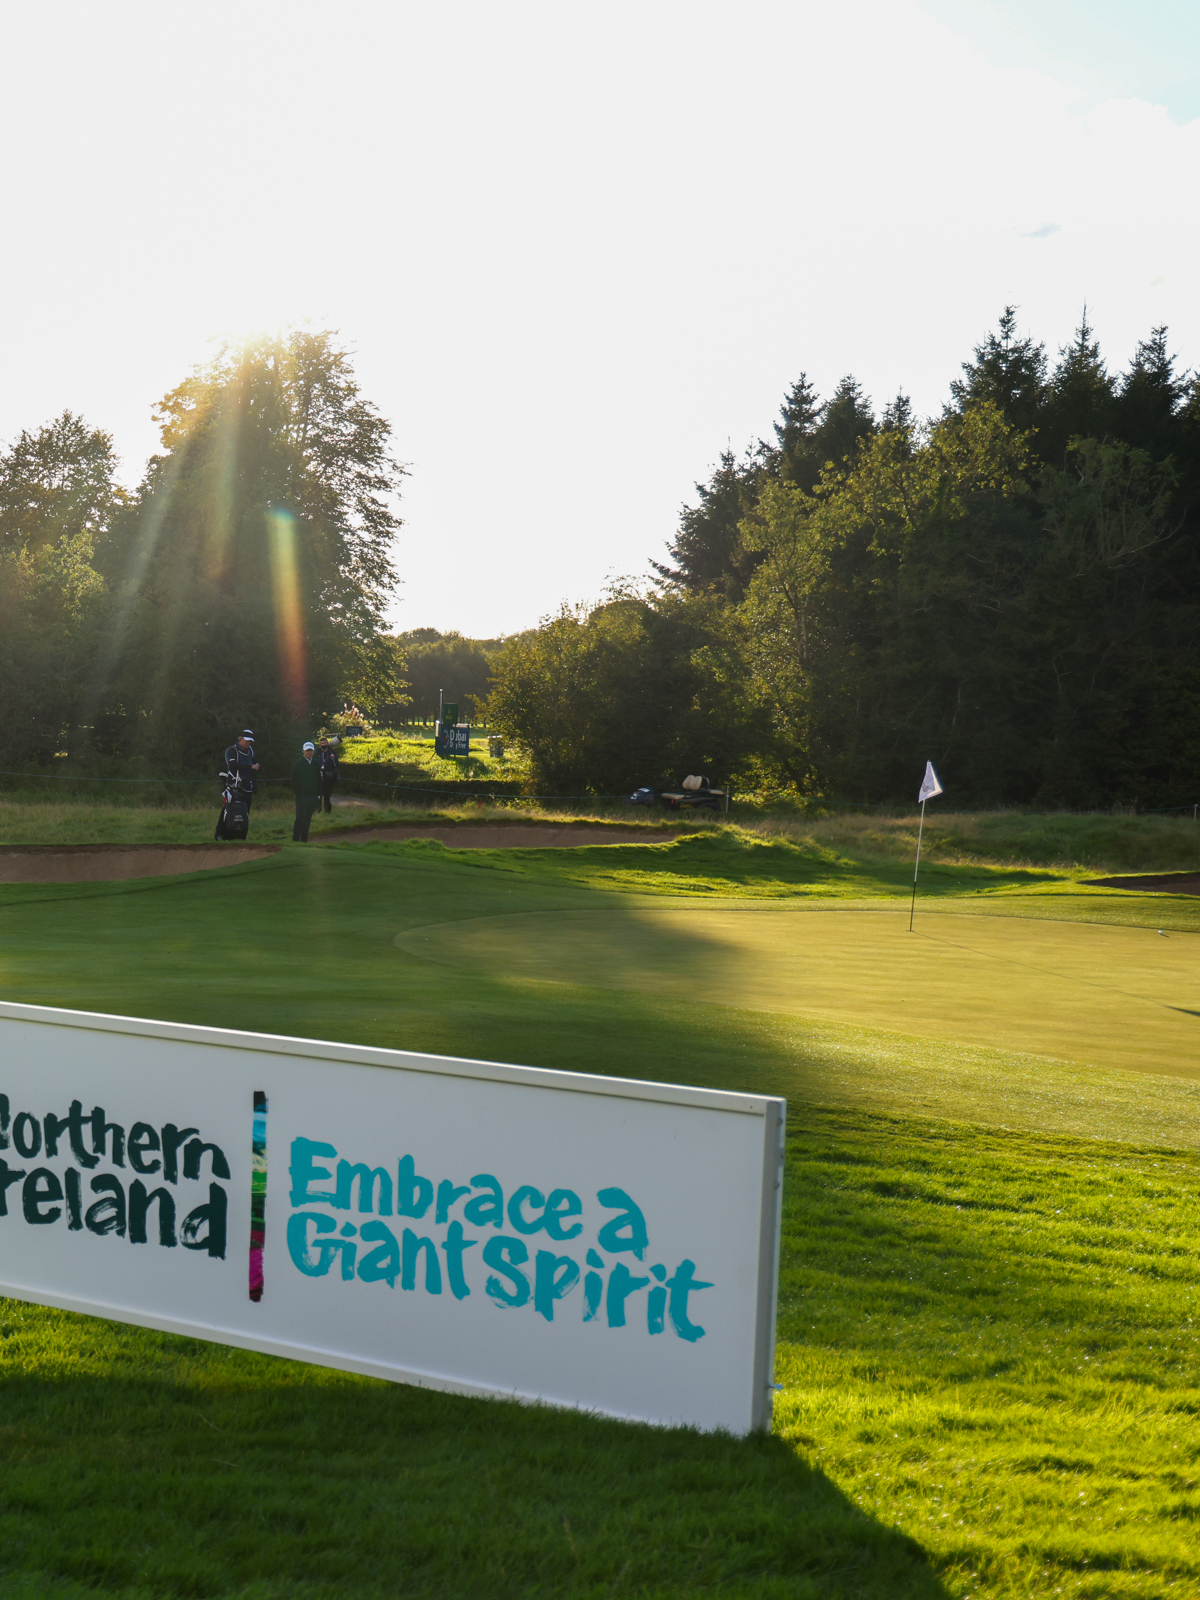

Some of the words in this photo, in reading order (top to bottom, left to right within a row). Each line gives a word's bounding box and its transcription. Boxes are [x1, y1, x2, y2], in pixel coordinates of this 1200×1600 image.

[288, 1136, 585, 1241] Embrace
[596, 1186, 648, 1262] a
[286, 1210, 479, 1301] Giant
[484, 1234, 716, 1344] Spirit
